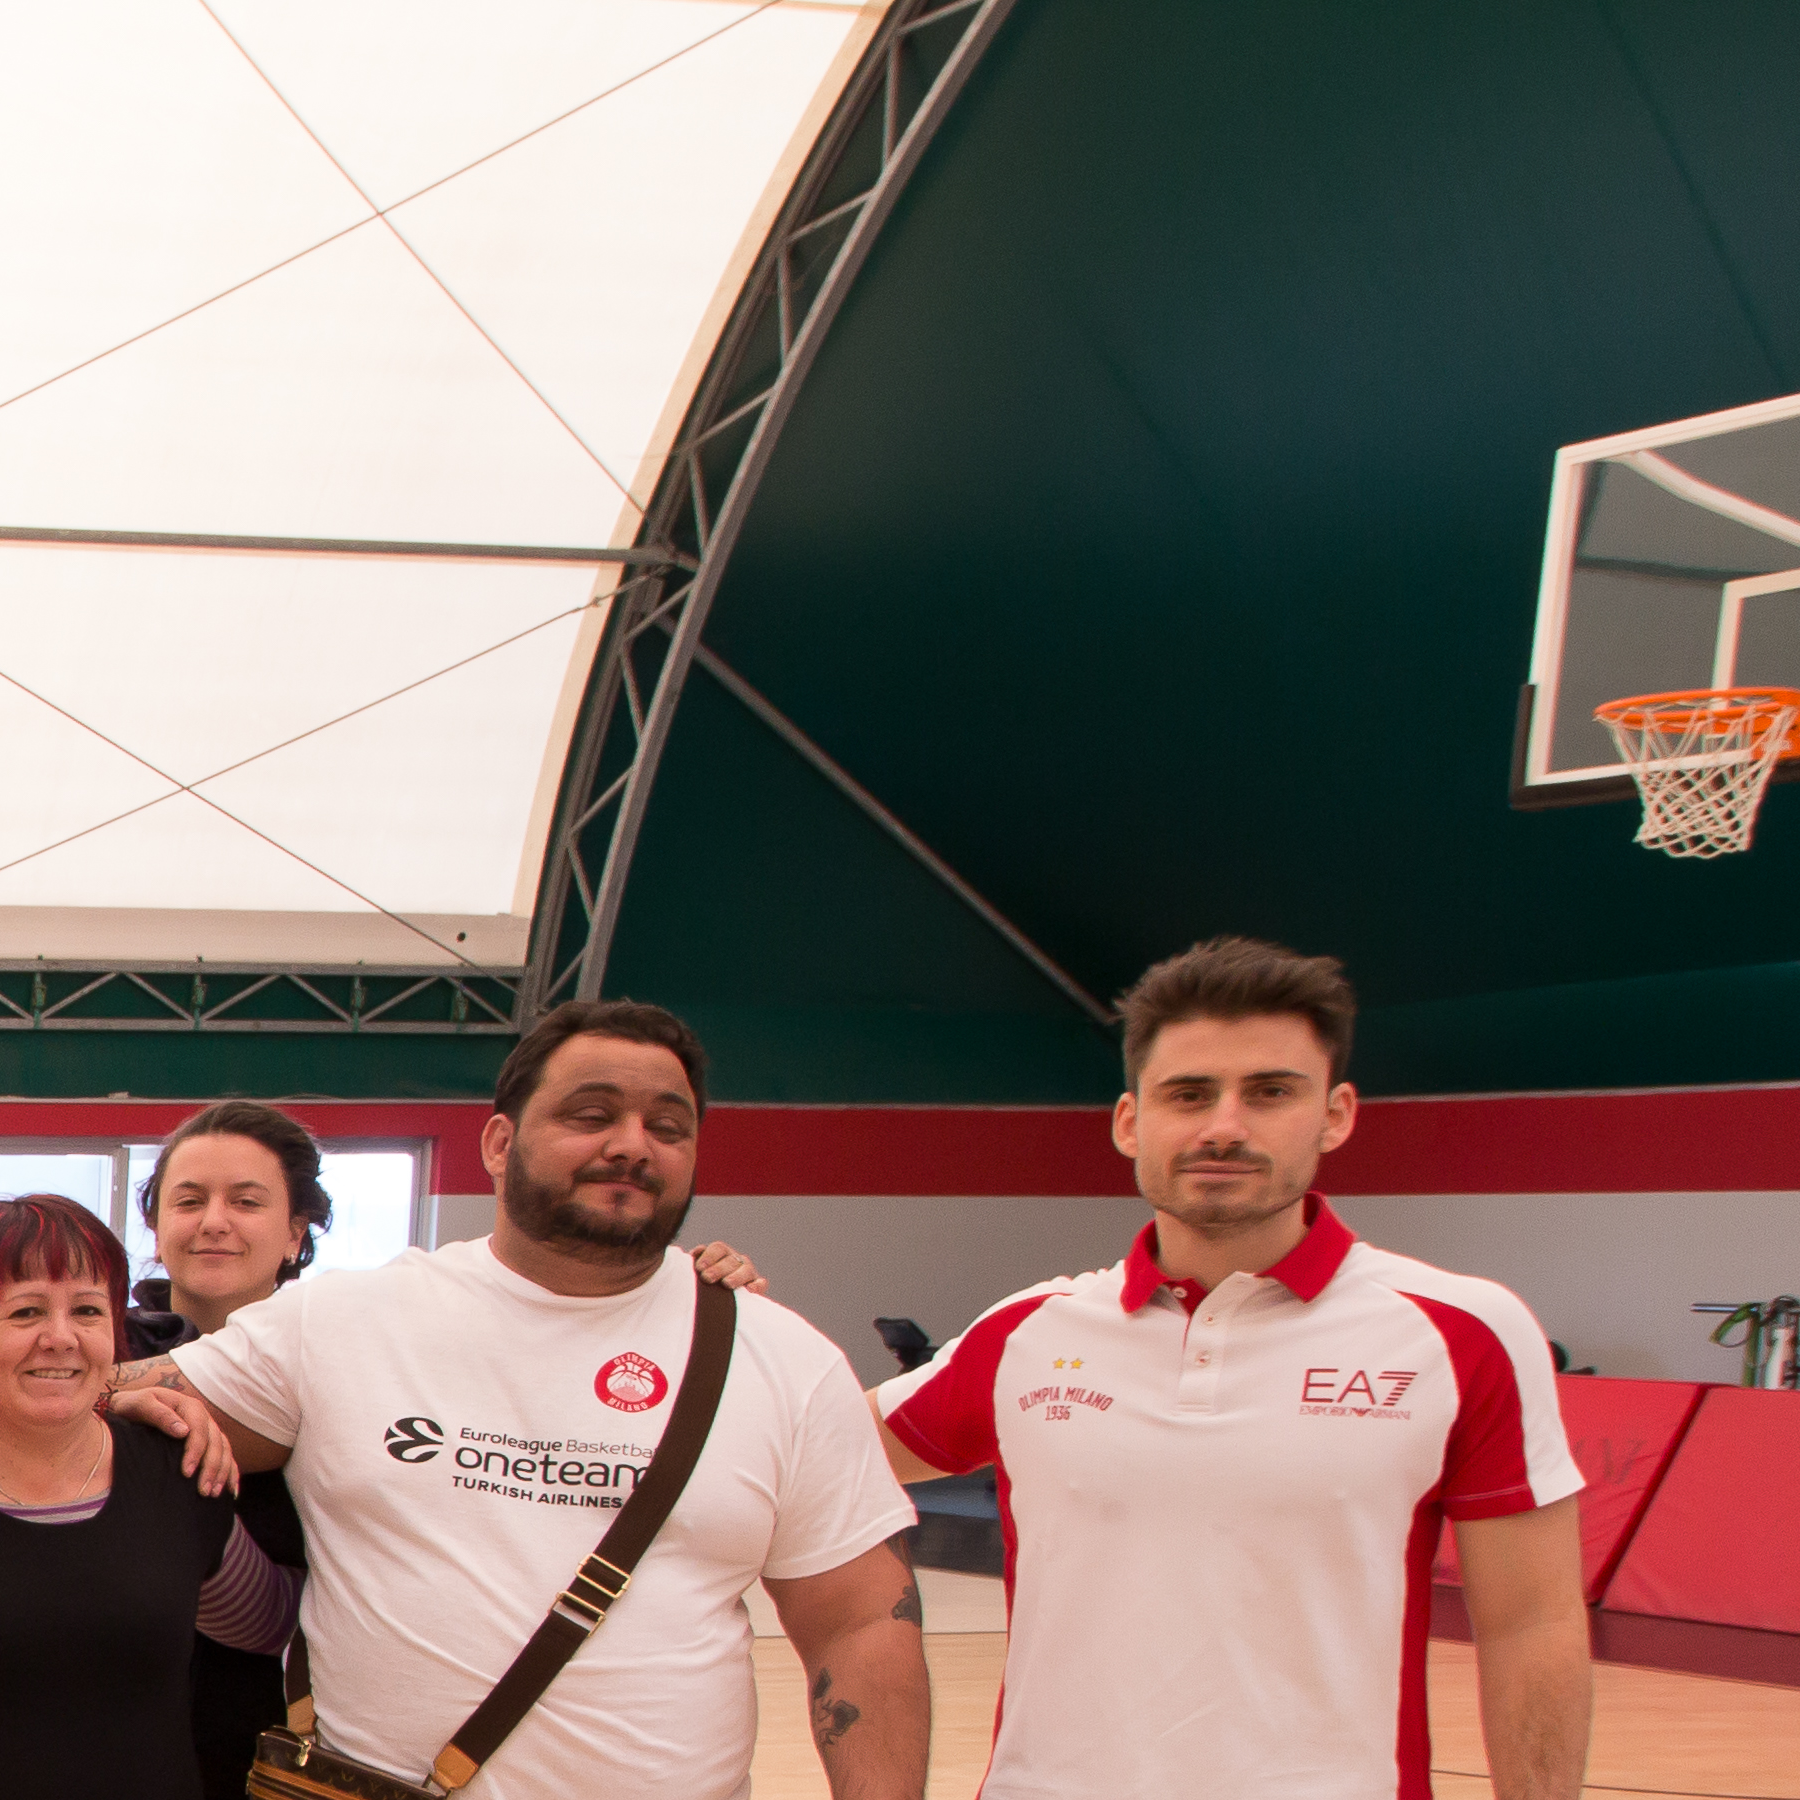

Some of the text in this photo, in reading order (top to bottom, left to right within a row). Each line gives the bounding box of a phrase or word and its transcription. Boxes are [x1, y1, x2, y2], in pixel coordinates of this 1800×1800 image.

[1018, 1386, 1114, 1412] OLIMPIA MILANO
[1301, 1368, 1419, 1407] EA7
[1044, 1405, 1072, 1421] 1936
[459, 1427, 656, 1459] Euroleague Basketba
[452, 1475, 623, 1509] TURKISH AIRLINES
